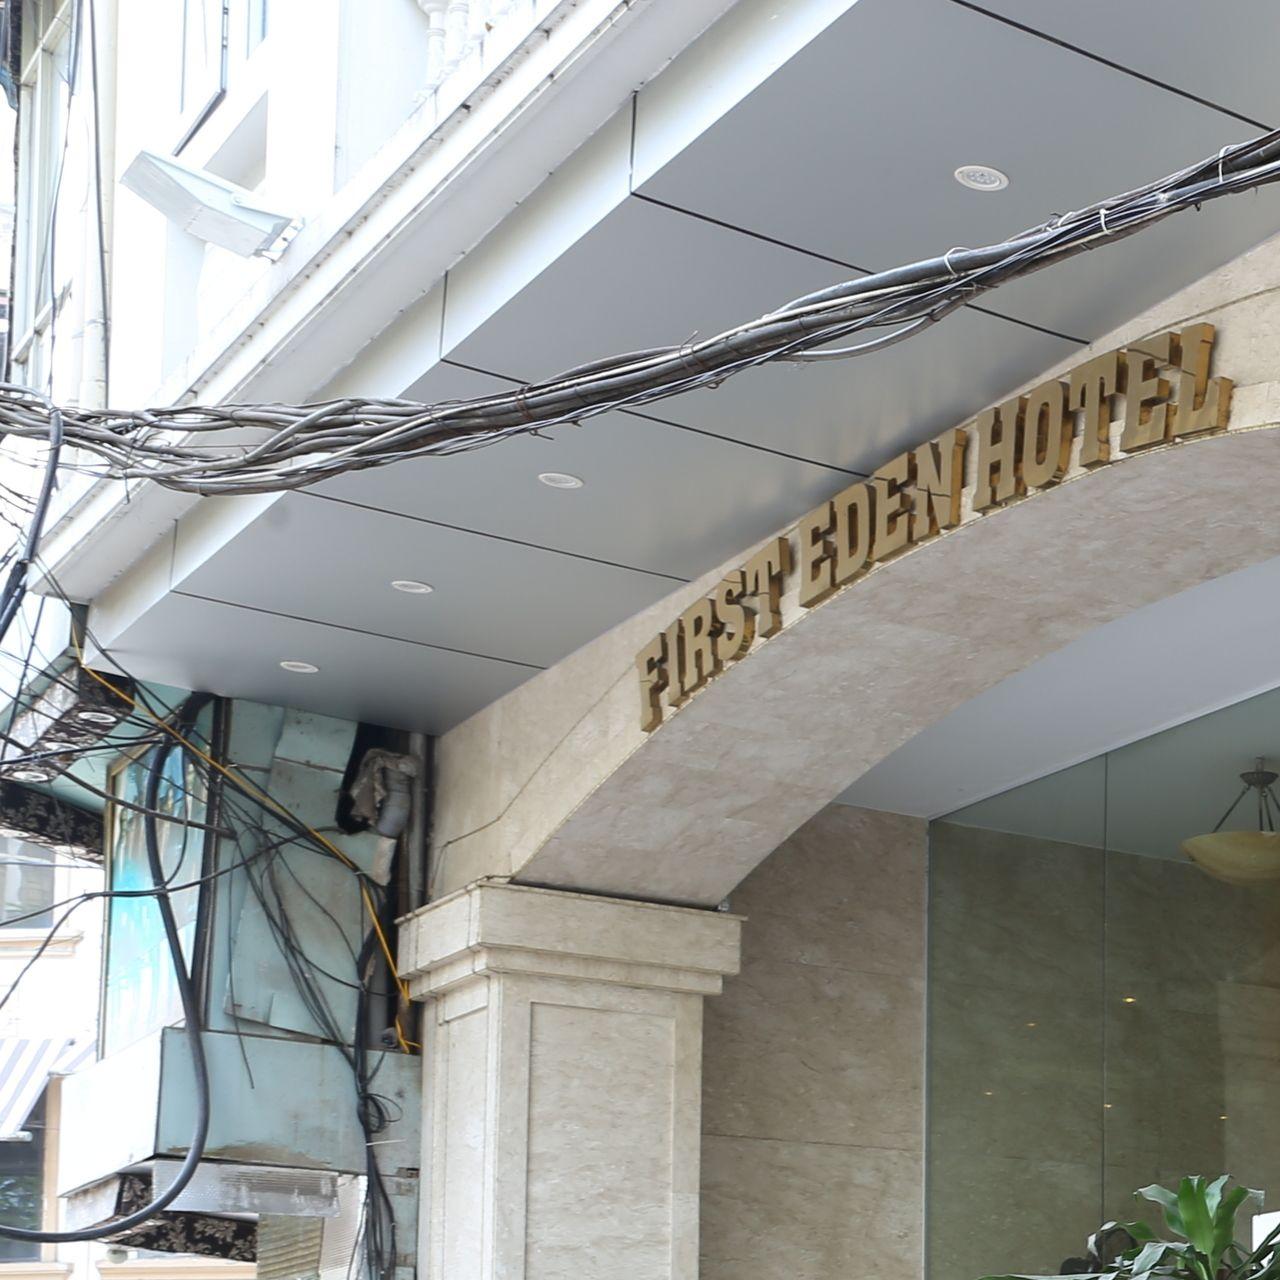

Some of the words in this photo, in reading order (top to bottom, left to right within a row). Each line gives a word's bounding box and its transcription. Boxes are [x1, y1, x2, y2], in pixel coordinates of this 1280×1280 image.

[635, 536, 790, 732] FIRST
[799, 429, 966, 608] EDEN
[972, 322, 1233, 513] HOTEL
